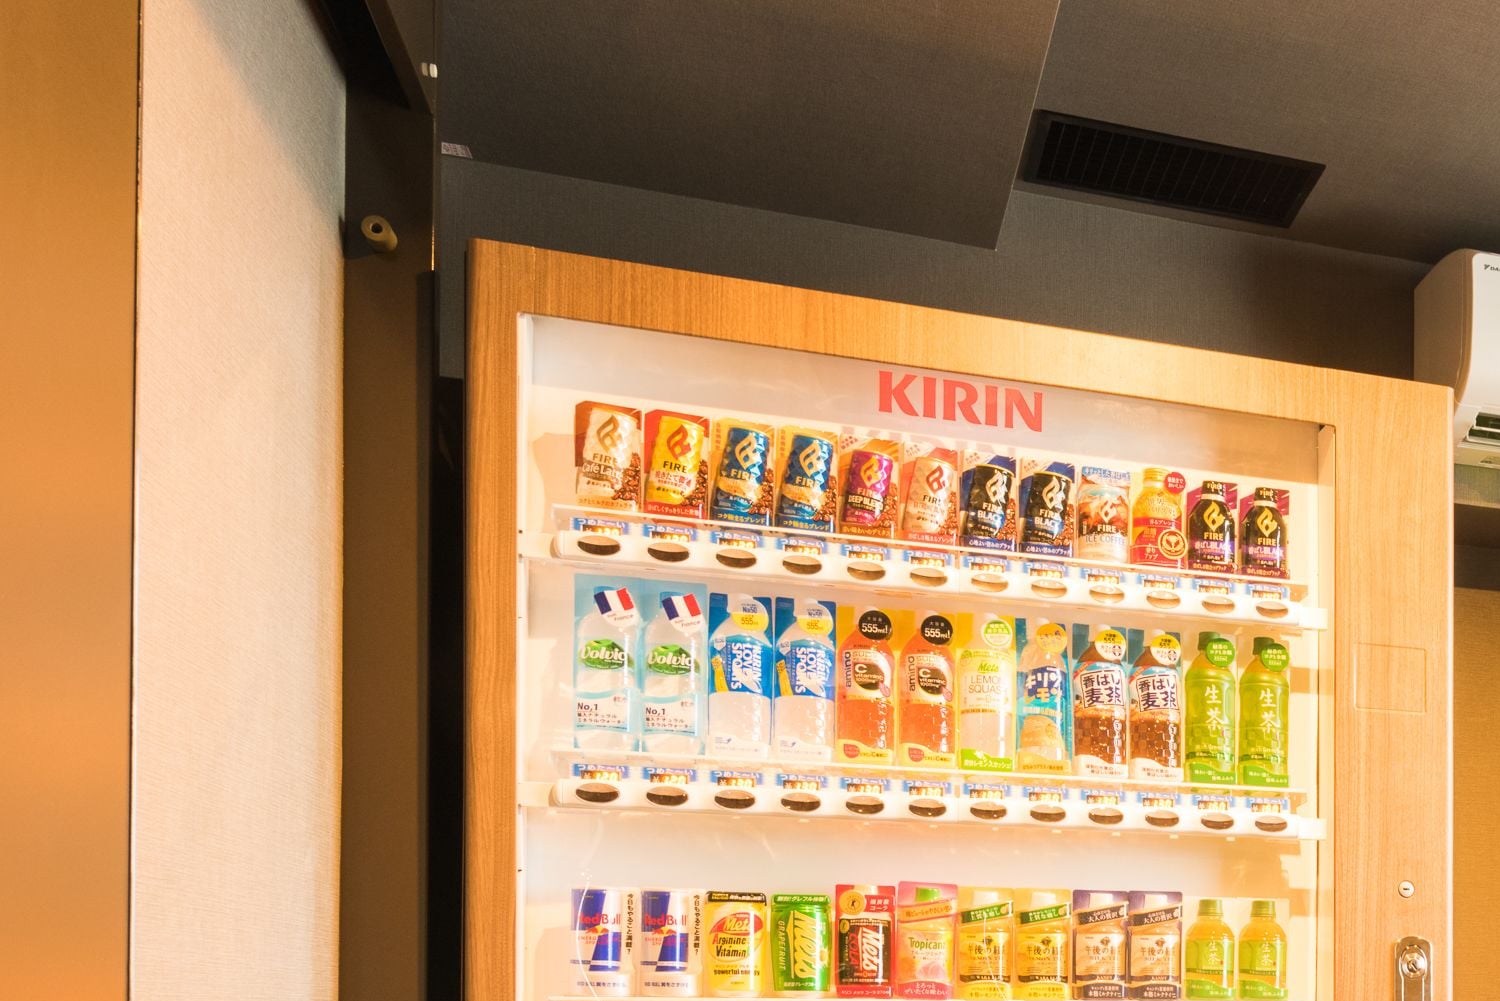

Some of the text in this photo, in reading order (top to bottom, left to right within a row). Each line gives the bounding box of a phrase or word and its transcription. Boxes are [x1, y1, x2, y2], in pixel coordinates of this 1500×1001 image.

[879, 370, 1042, 432] KIRIN
[663, 461, 688, 473] FIRE
[1098, 524, 1117, 533] FIRE
[1204, 532, 1224, 540] FIRE
[1258, 538, 1276, 546] FIRE
[581, 646, 625, 662] Volvic
[648, 651, 693, 667] Volvic
[855, 663, 866, 673] C
[919, 668, 931, 678] C
[970, 675, 1000, 684] LEMO
[1025, 674, 1063, 690] キリン
[1082, 674, 1120, 688] 香ばし
[968, 684, 1003, 694] SQUAS
[1139, 679, 1175, 693] 香ばし
[1085, 687, 1122, 706] 麦茶
[1141, 692, 1177, 709] 麦茶
[1205, 684, 1224, 731] 生茶
[1259, 688, 1279, 734] 生茶
[723, 919, 750, 931] Met
[713, 934, 746, 946] Arginine
[778, 920, 786, 971] GRAPEFRUIT
[716, 946, 747, 957] Vitamin
[862, 927, 879, 971] Mets
[968, 944, 1004, 955] 午後の紅
[1026, 945, 1062, 955] 午後の紅
